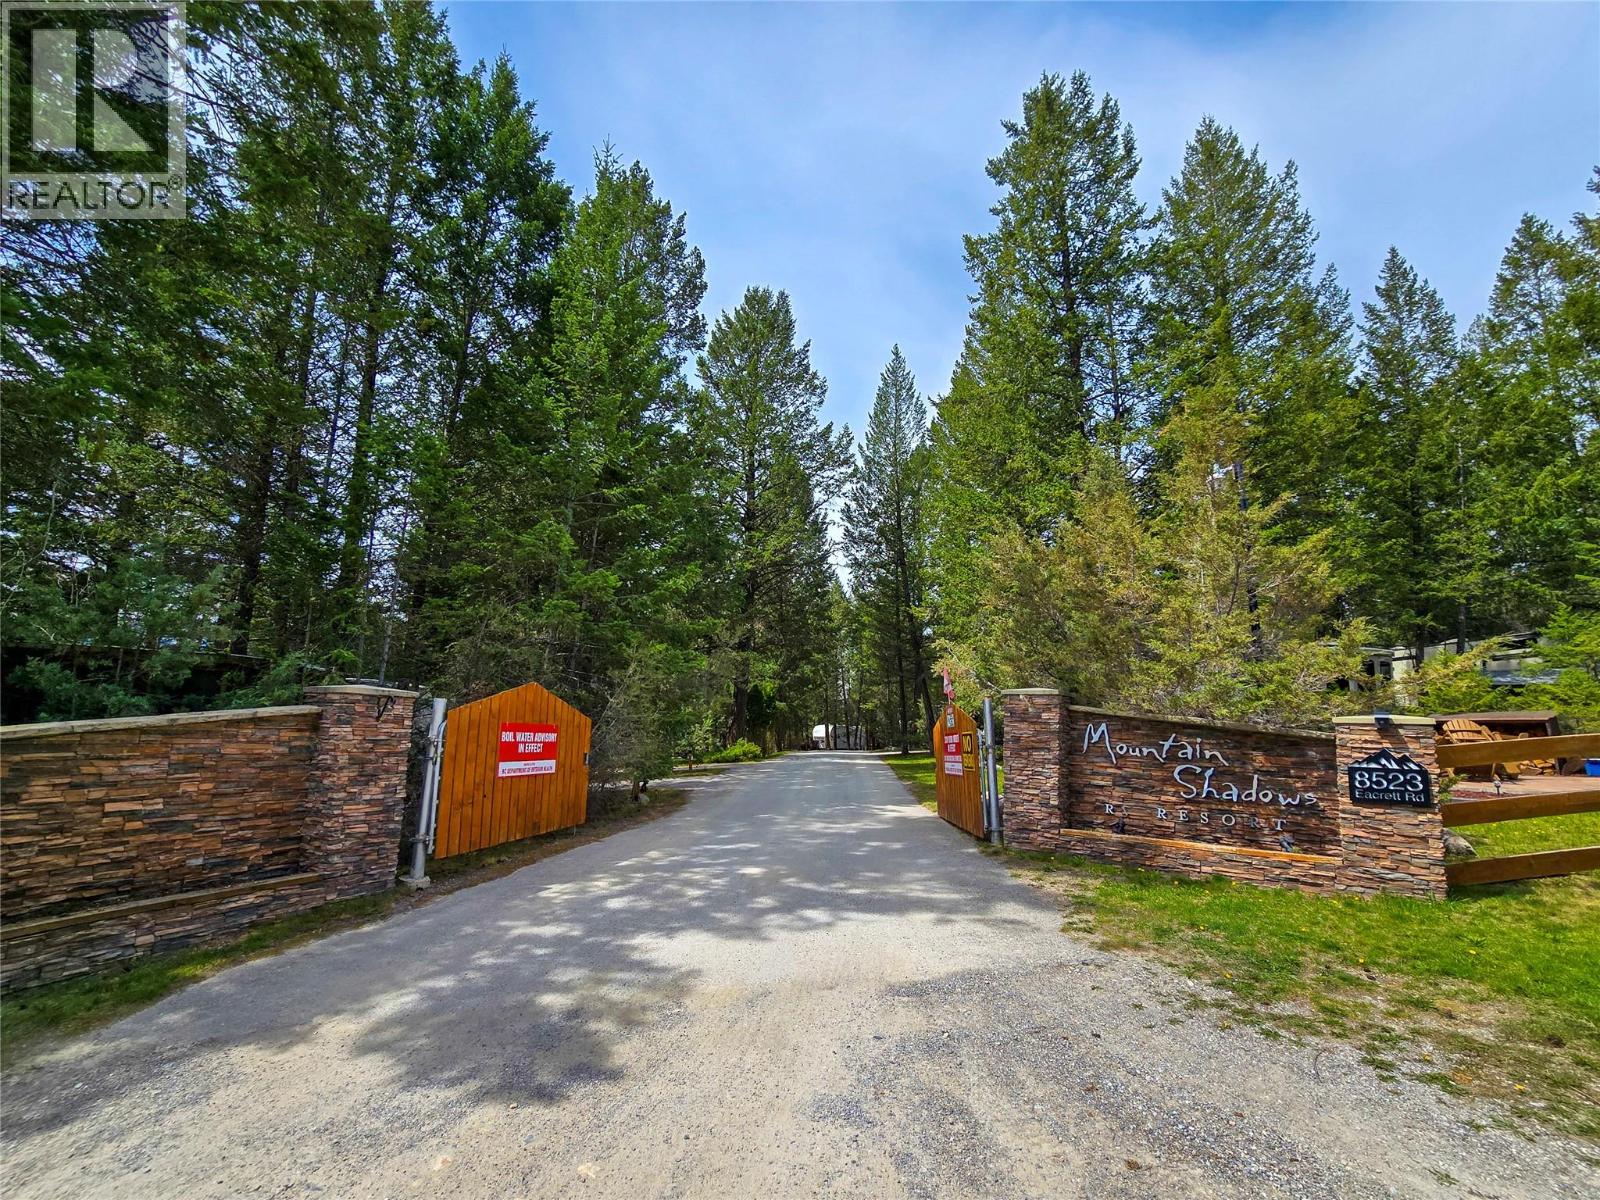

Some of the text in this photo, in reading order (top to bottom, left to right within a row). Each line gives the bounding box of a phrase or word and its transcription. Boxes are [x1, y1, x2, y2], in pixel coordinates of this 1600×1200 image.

[501, 731, 557, 742] BOIL WATER ADVISORY
[963, 735, 972, 753] NO
[1083, 722, 1230, 767] Mountain
[518, 743, 543, 753] IN EFFECT
[1173, 764, 1318, 807] Shadows
[1354, 771, 1423, 791] 8523
[1405, 792, 1425, 802] Rd
[1156, 807, 1287, 831] RESORT
